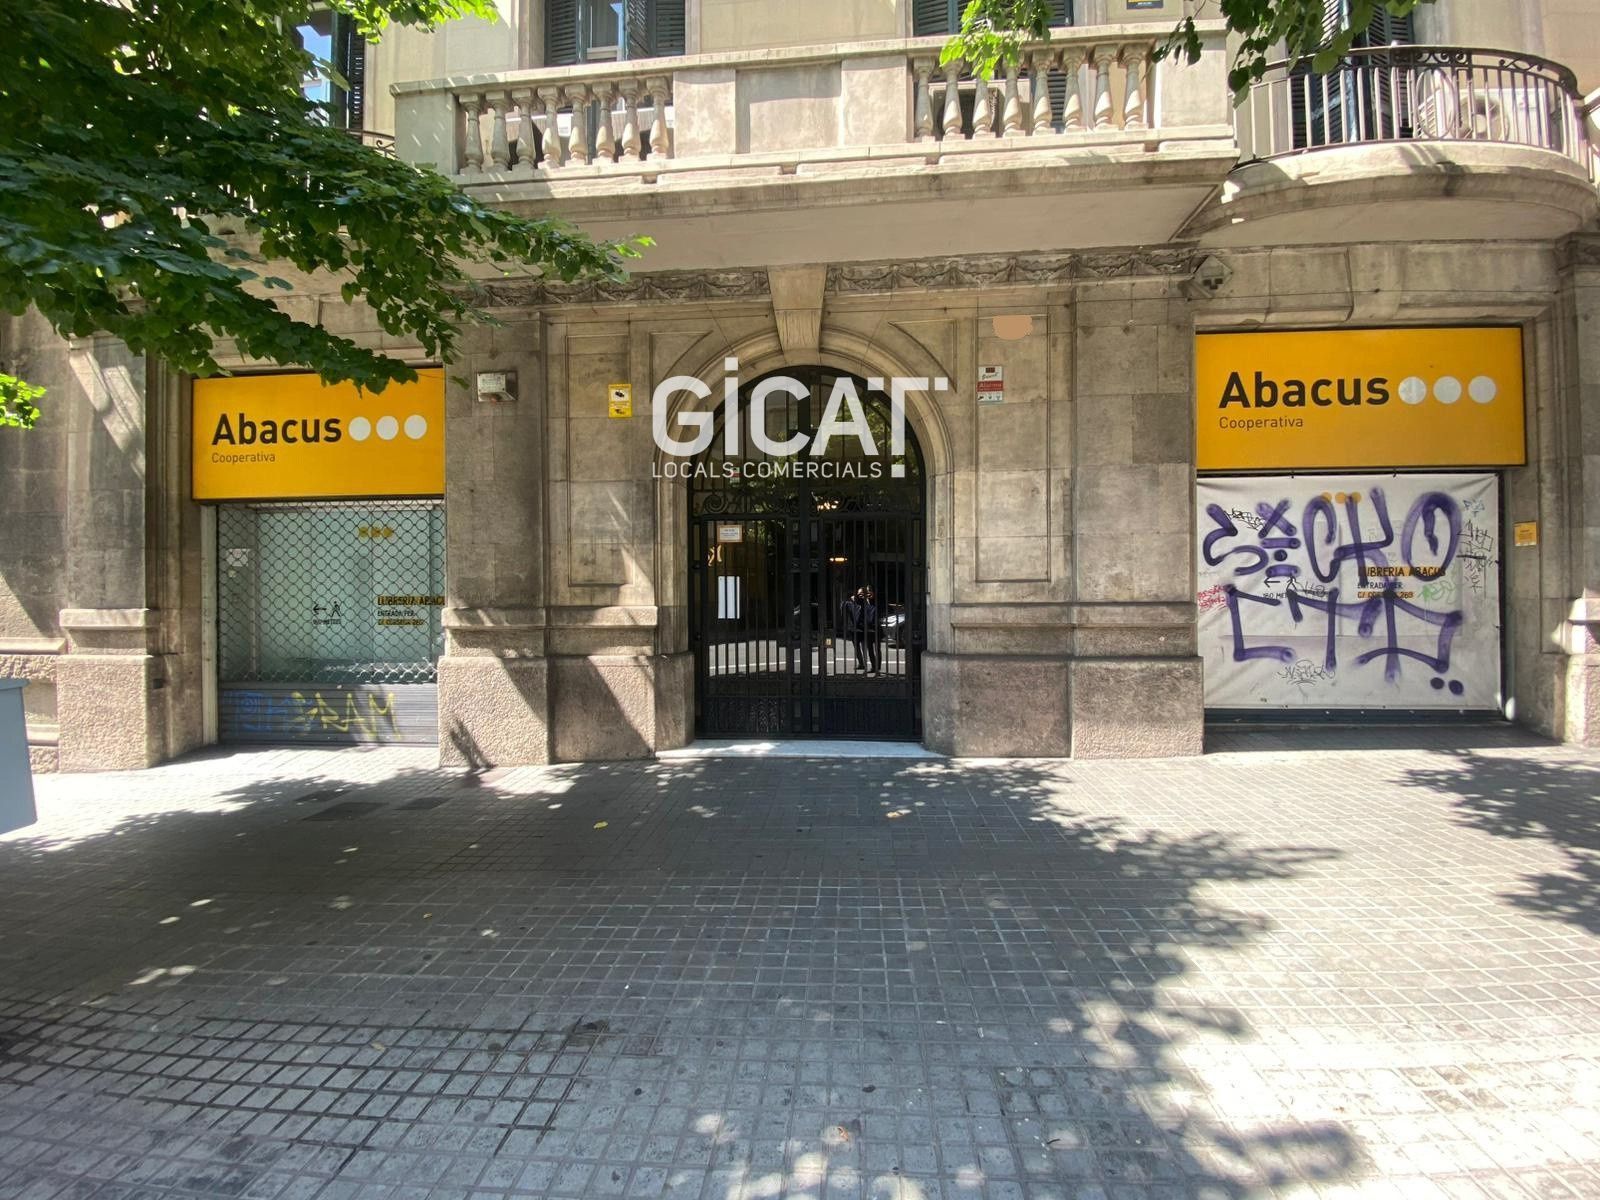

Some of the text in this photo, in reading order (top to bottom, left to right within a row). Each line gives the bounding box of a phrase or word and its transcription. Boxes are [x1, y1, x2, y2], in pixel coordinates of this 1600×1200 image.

[1218, 371, 1390, 409] Abacus
[211, 413, 342, 446] Abacus
[1219, 415, 1304, 431] Cooperativa
[211, 451, 276, 464] Cooperativa
[1358, 566, 1405, 577] IBRERIA
